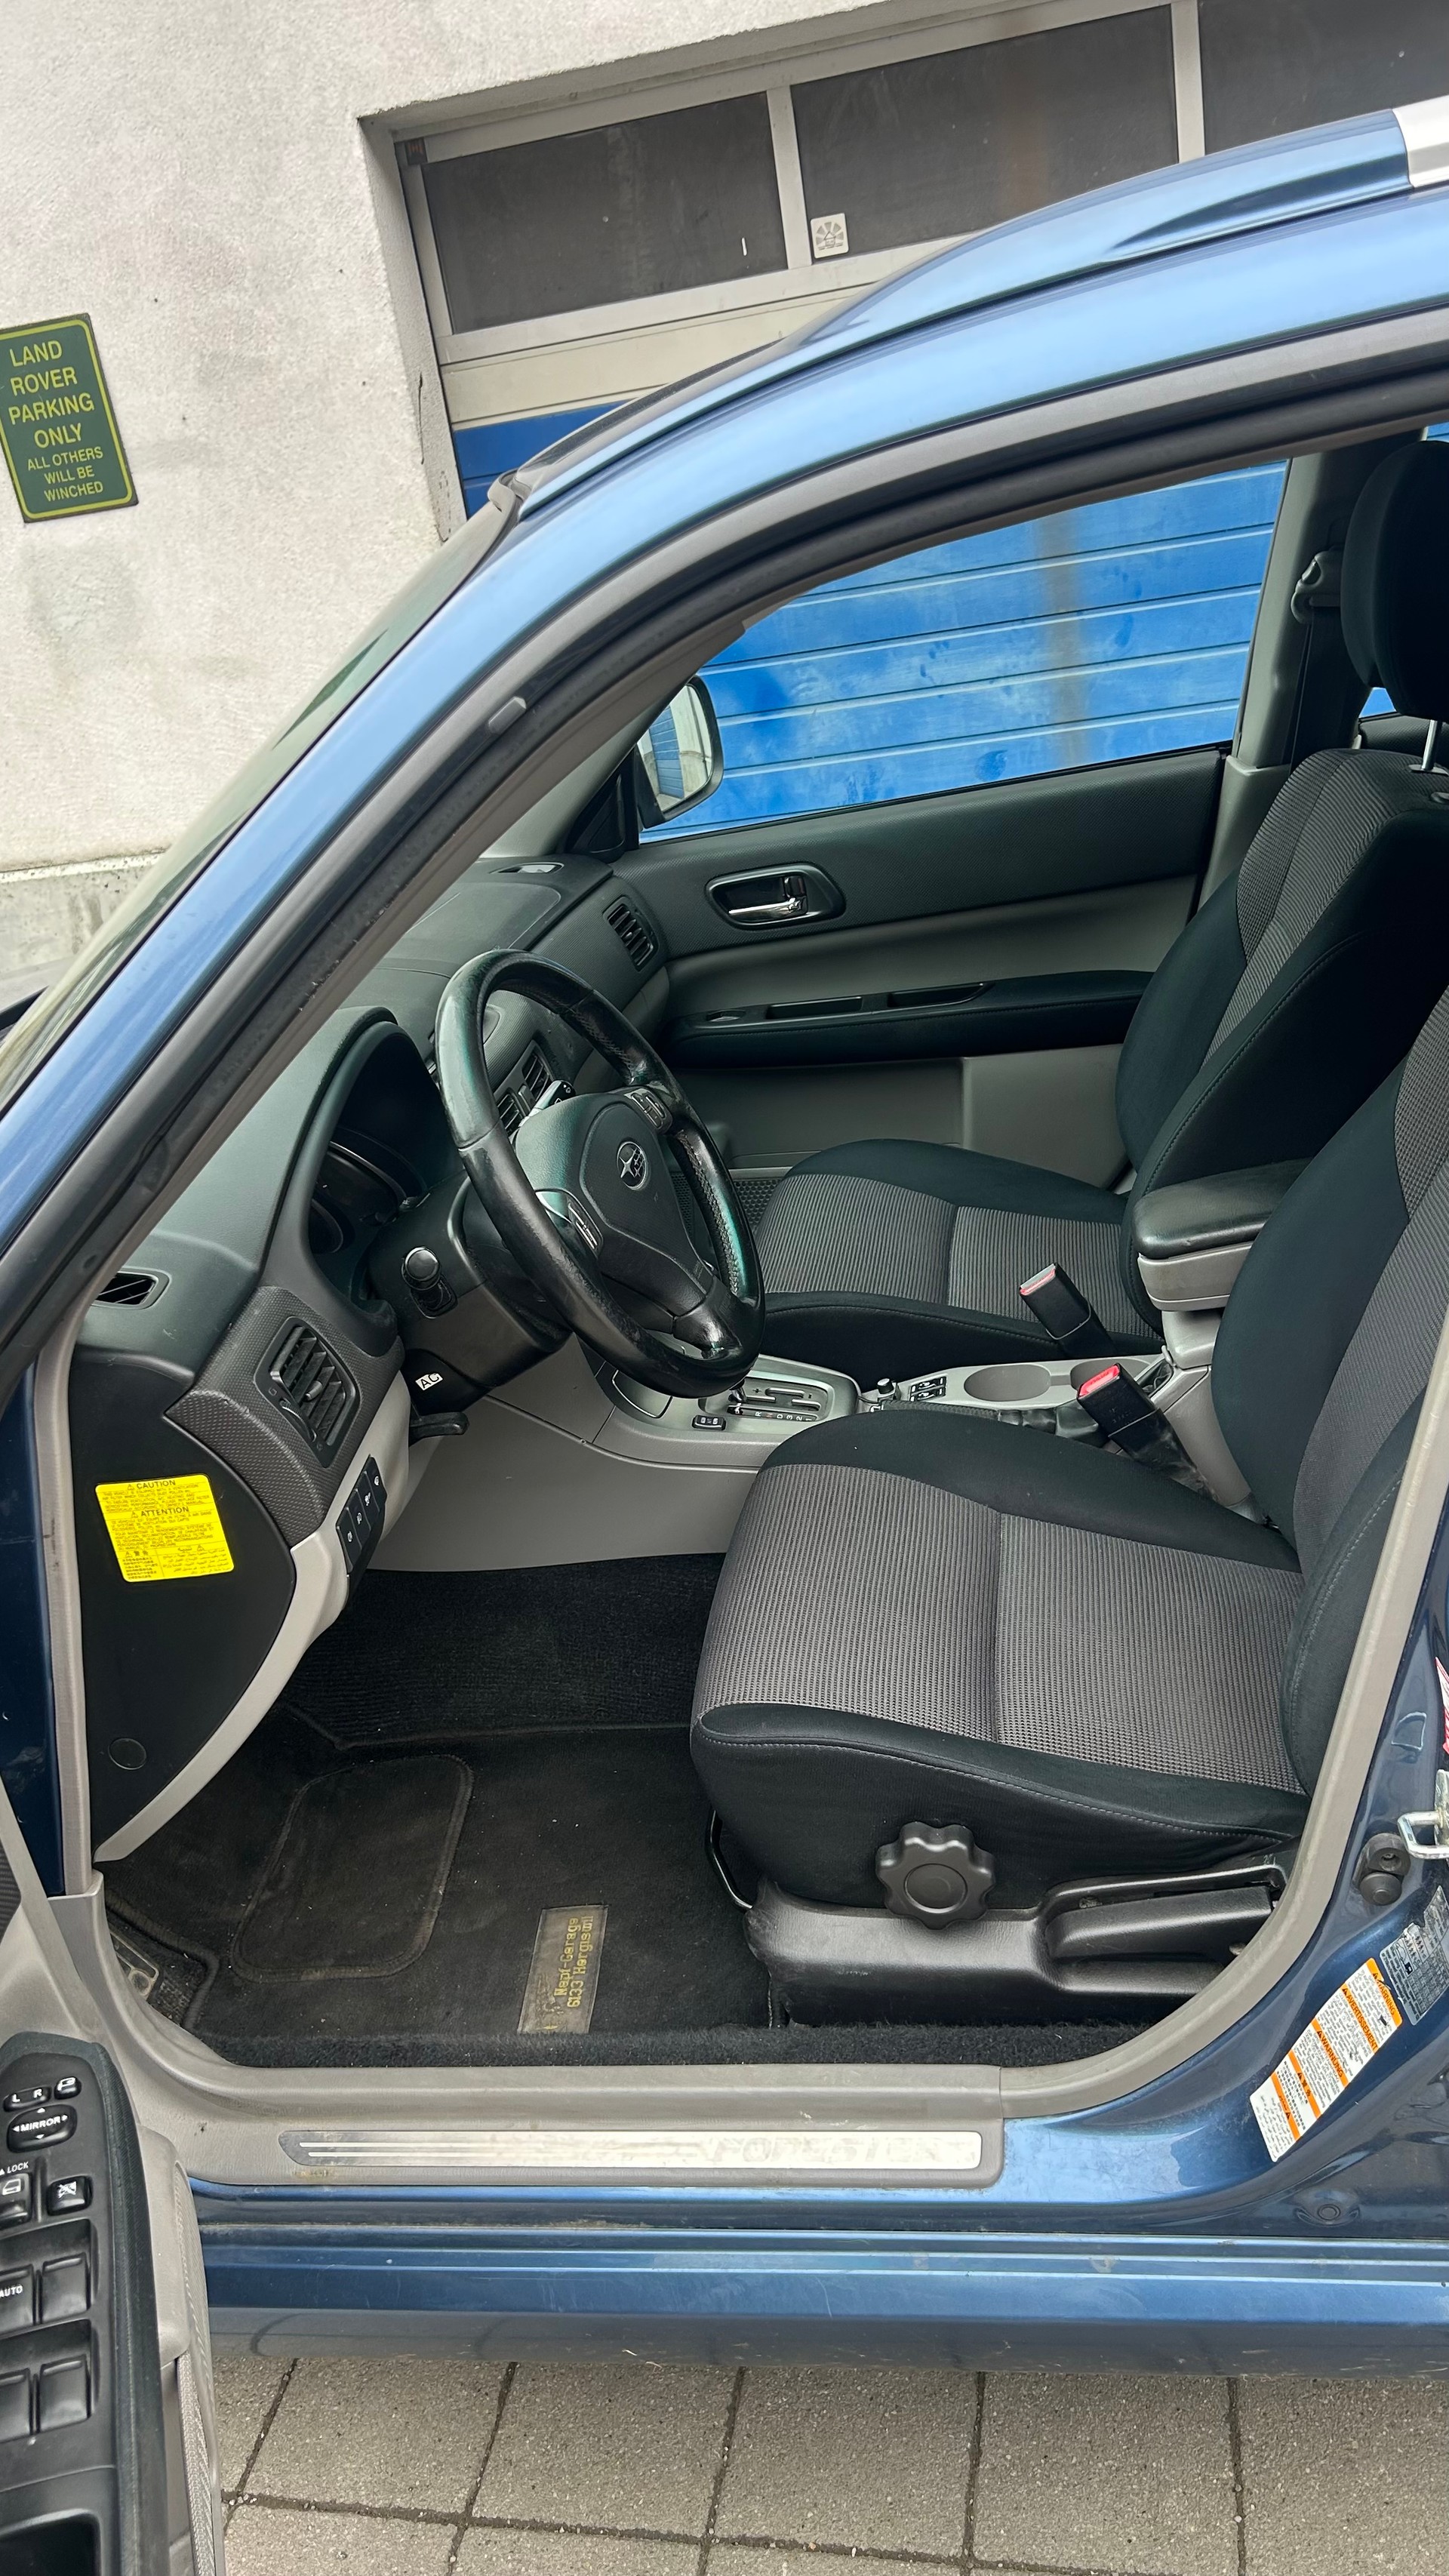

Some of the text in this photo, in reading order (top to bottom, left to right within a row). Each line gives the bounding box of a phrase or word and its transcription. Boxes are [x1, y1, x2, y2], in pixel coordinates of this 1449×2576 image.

[10, 340, 63, 367] LAND
[11, 367, 78, 396] ROVER
[8, 392, 94, 425] PARKING
[34, 423, 82, 448] ONLY
[27, 446, 103, 471] ALL OTHERS
[44, 465, 95, 485] WILL BE
[44, 481, 104, 502] WINCHED
[136, 1479, 177, 1490] CAUTION
[140, 1506, 189, 1518] ATTENTION
[1346, 1994, 1379, 2051] AVERTISSEMENT
[1321, 2037, 1344, 2078] WARNUNG
[11, 2088, 42, 2103] L R
[20, 2116, 61, 2132] MIRROR
[7, 2161, 29, 2174] LOCK
